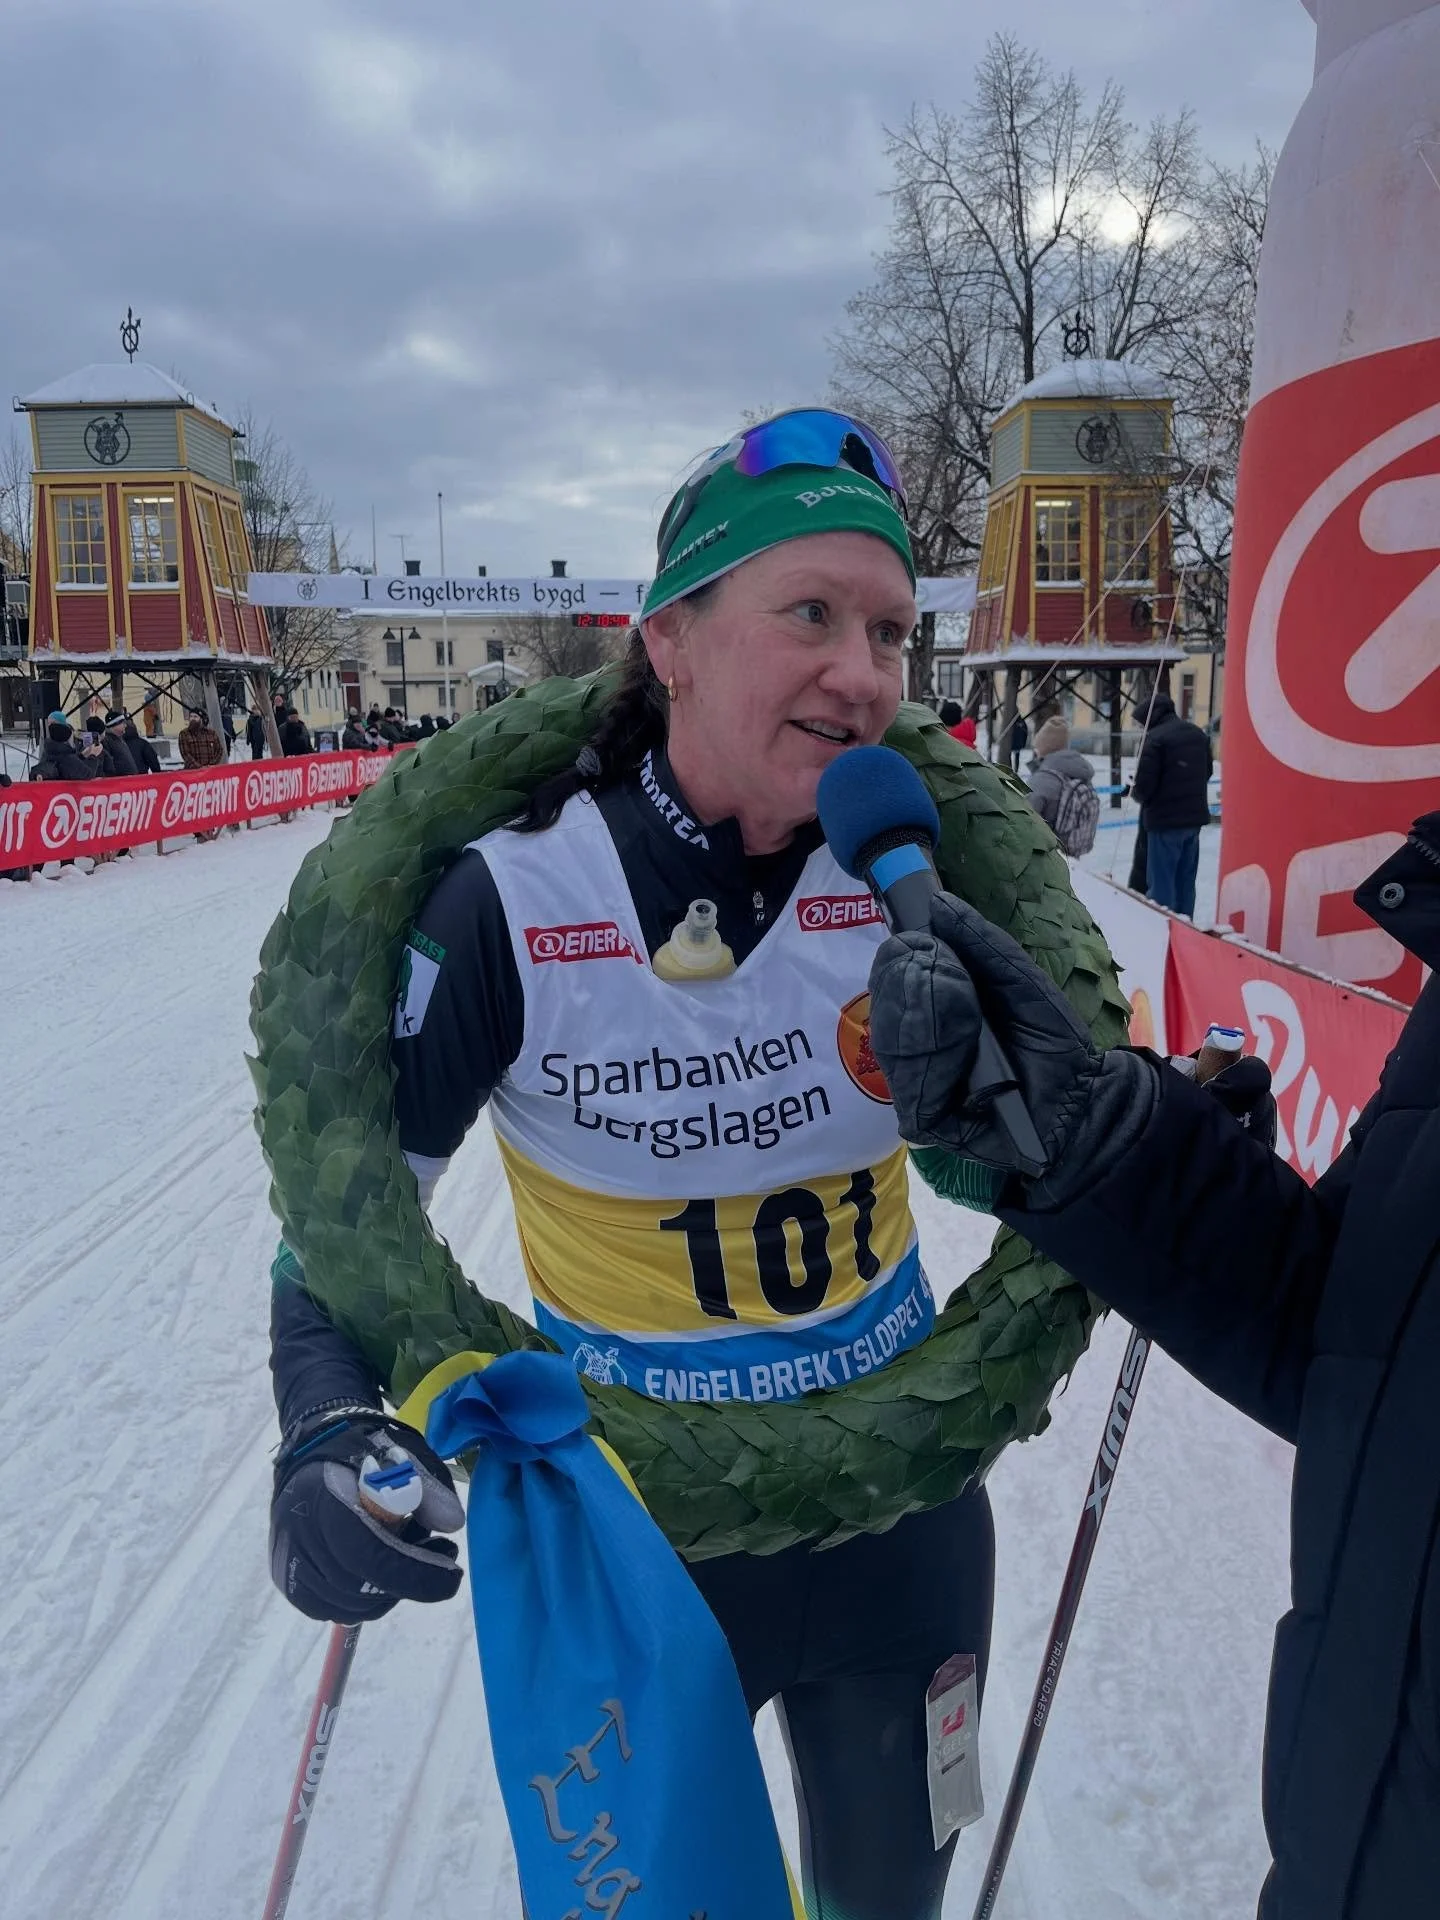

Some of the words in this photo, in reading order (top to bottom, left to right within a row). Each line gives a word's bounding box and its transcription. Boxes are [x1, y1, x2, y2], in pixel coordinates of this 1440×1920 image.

[360, 579, 371, 602] I
[387, 578, 521, 607] Engelbrekts
[533, 582, 586, 610] bygd
[76, 787, 159, 843] ENERVIT
[182, 775, 240, 823] ENERVIT
[262, 766, 302, 807] ENERVIT
[541, 1026, 815, 1107] Sparbanken
[659, 1168, 881, 1321] 101
[644, 1286, 924, 1403] ENGELBREKTSLOPPET
